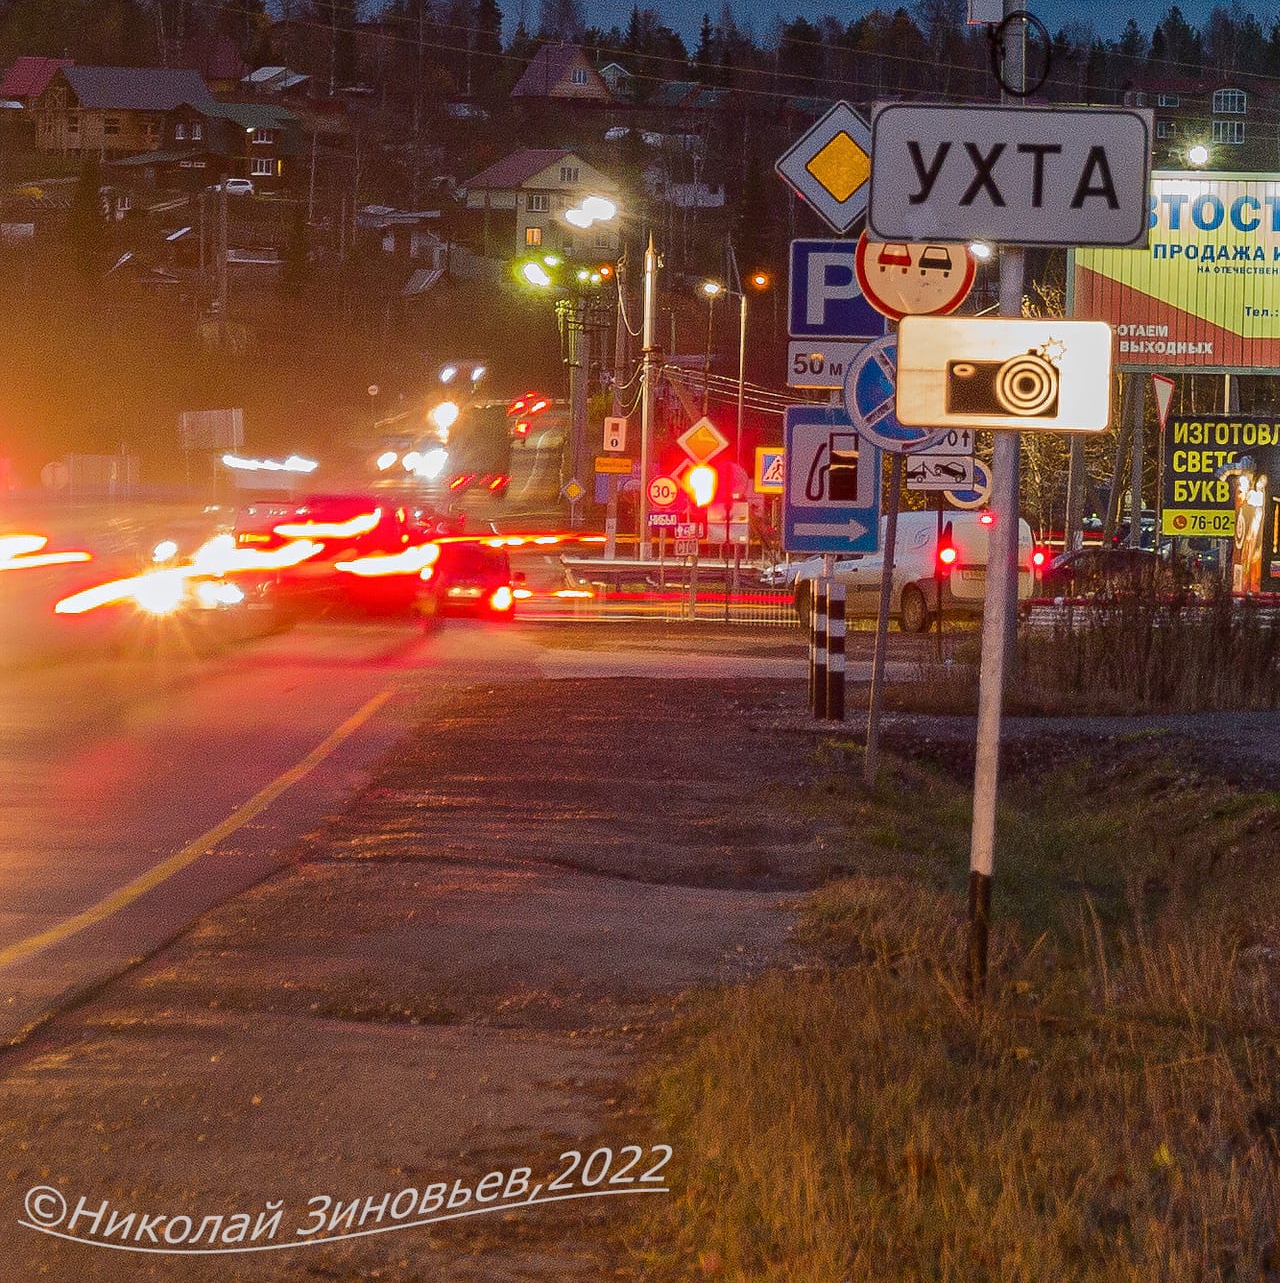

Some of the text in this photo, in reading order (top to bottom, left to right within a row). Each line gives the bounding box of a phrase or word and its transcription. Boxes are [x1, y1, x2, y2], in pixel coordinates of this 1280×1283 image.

[907, 140, 1121, 210] УХТА
[1153, 244, 1266, 263] ПРОДАЖА
[1197, 266, 1211, 275] НА
[806, 253, 863, 325] P
[1245, 306, 1280, 319] Тел.:
[1120, 341, 1213, 355] ВЫХОДНЫХ
[792, 353, 825, 376] 50
[1174, 480, 1230, 502] БУКВ
